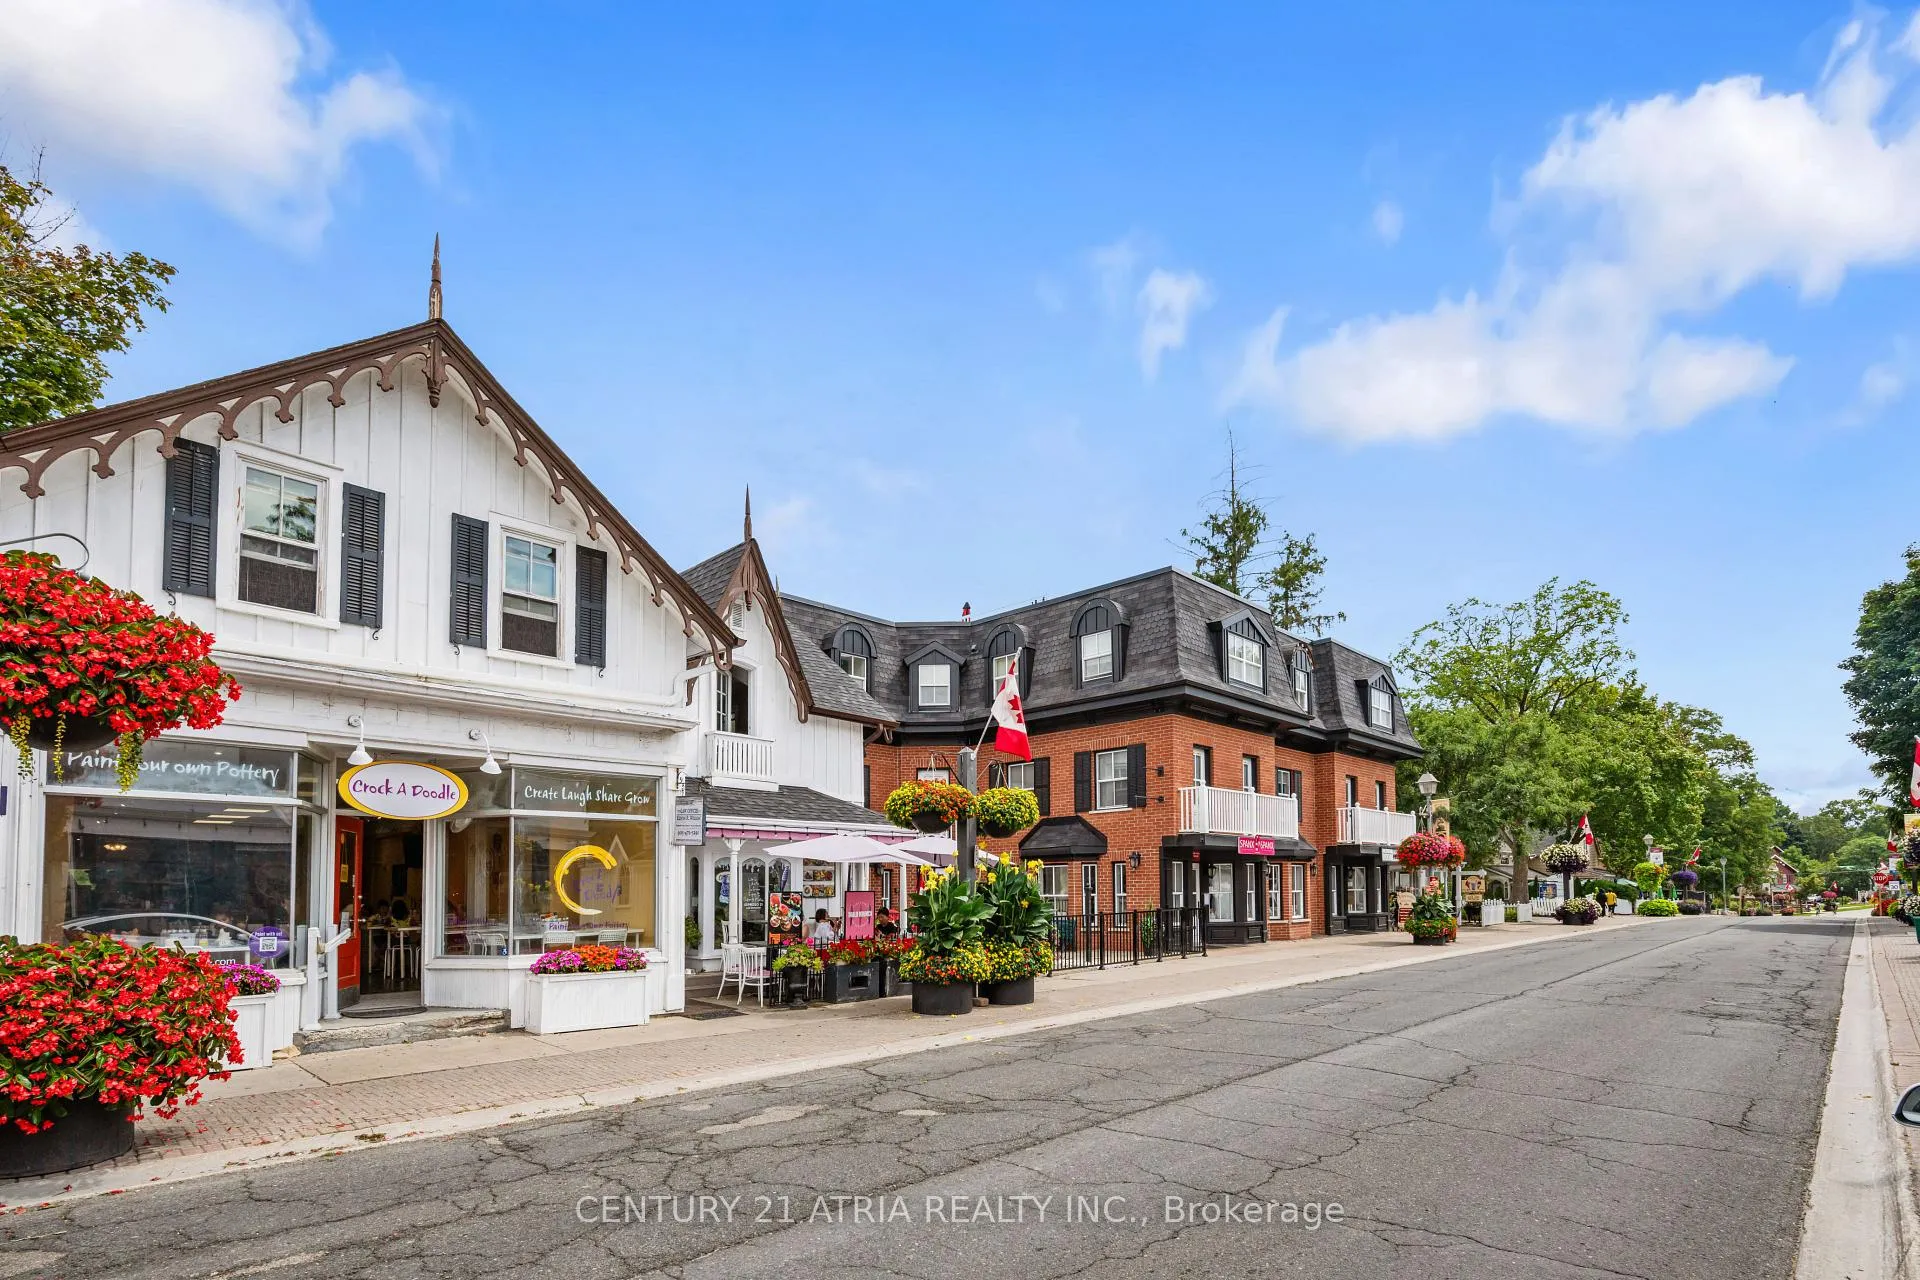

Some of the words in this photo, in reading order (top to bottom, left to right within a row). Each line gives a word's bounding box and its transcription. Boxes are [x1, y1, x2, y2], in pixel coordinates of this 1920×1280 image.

[136, 759, 170, 773] our
[173, 761, 211, 774] own
[216, 761, 280, 788] Pottery
[352, 778, 394, 796] Crock
[397, 782, 407, 796] A
[411, 783, 456, 800] Doodle
[524, 785, 559, 801] Create
[561, 784, 593, 807] Laugh
[595, 785, 623, 803] Share
[624, 791, 651, 804] Grow
[208, 958, 236, 966] .com
